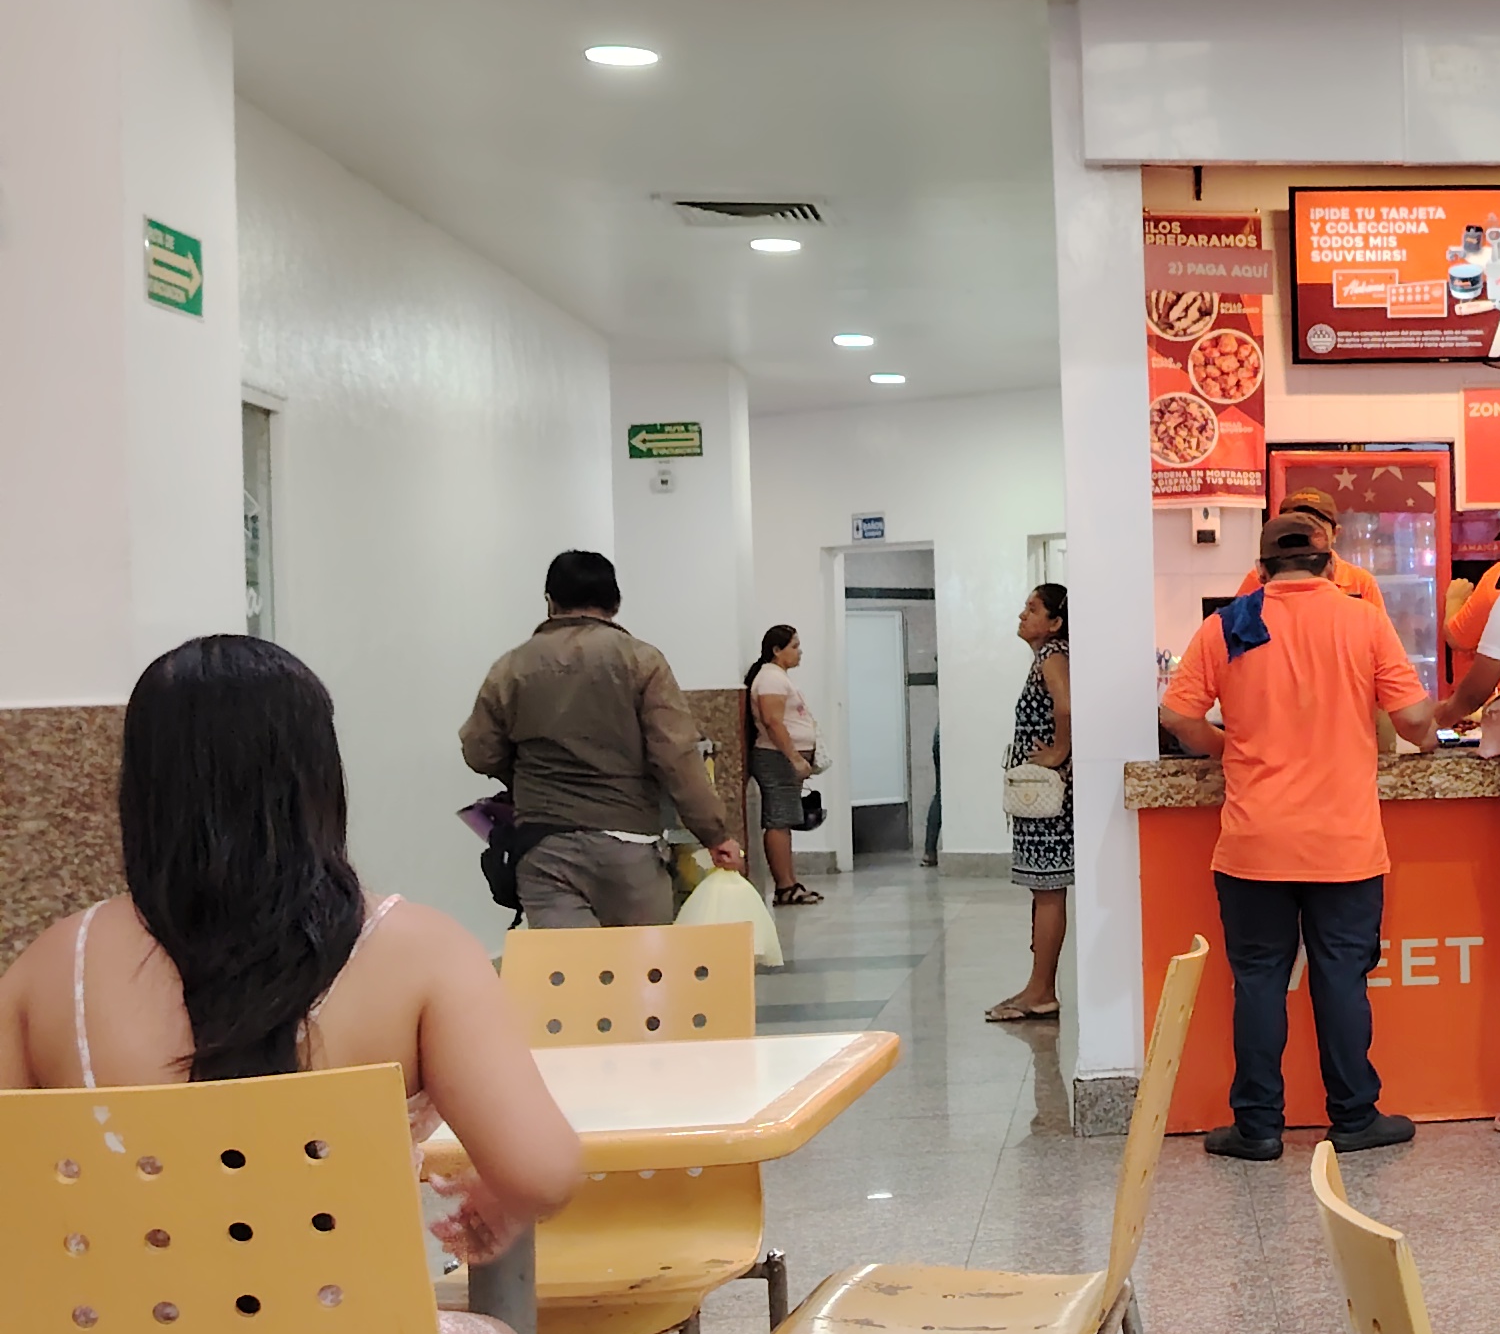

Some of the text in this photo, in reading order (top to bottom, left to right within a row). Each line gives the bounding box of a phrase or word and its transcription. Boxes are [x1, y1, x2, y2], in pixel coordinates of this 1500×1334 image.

[1355, 207, 1375, 220] TU
[1380, 206, 1446, 220] TARJETA
[1310, 221, 1429, 234] Y COLECCIONA
[1145, 234, 1258, 247] PREPARAMOS
[1310, 235, 1397, 248] TODOS MIS
[1310, 249, 1407, 262] SOUVENIRS!
[1187, 263, 1227, 277] PAGA
[1231, 262, 1268, 278] AQUÍ
[1151, 470, 1261, 480] ORDENA EN MOSTRADOR
[1158, 478, 1203, 486] DISFRUTA
